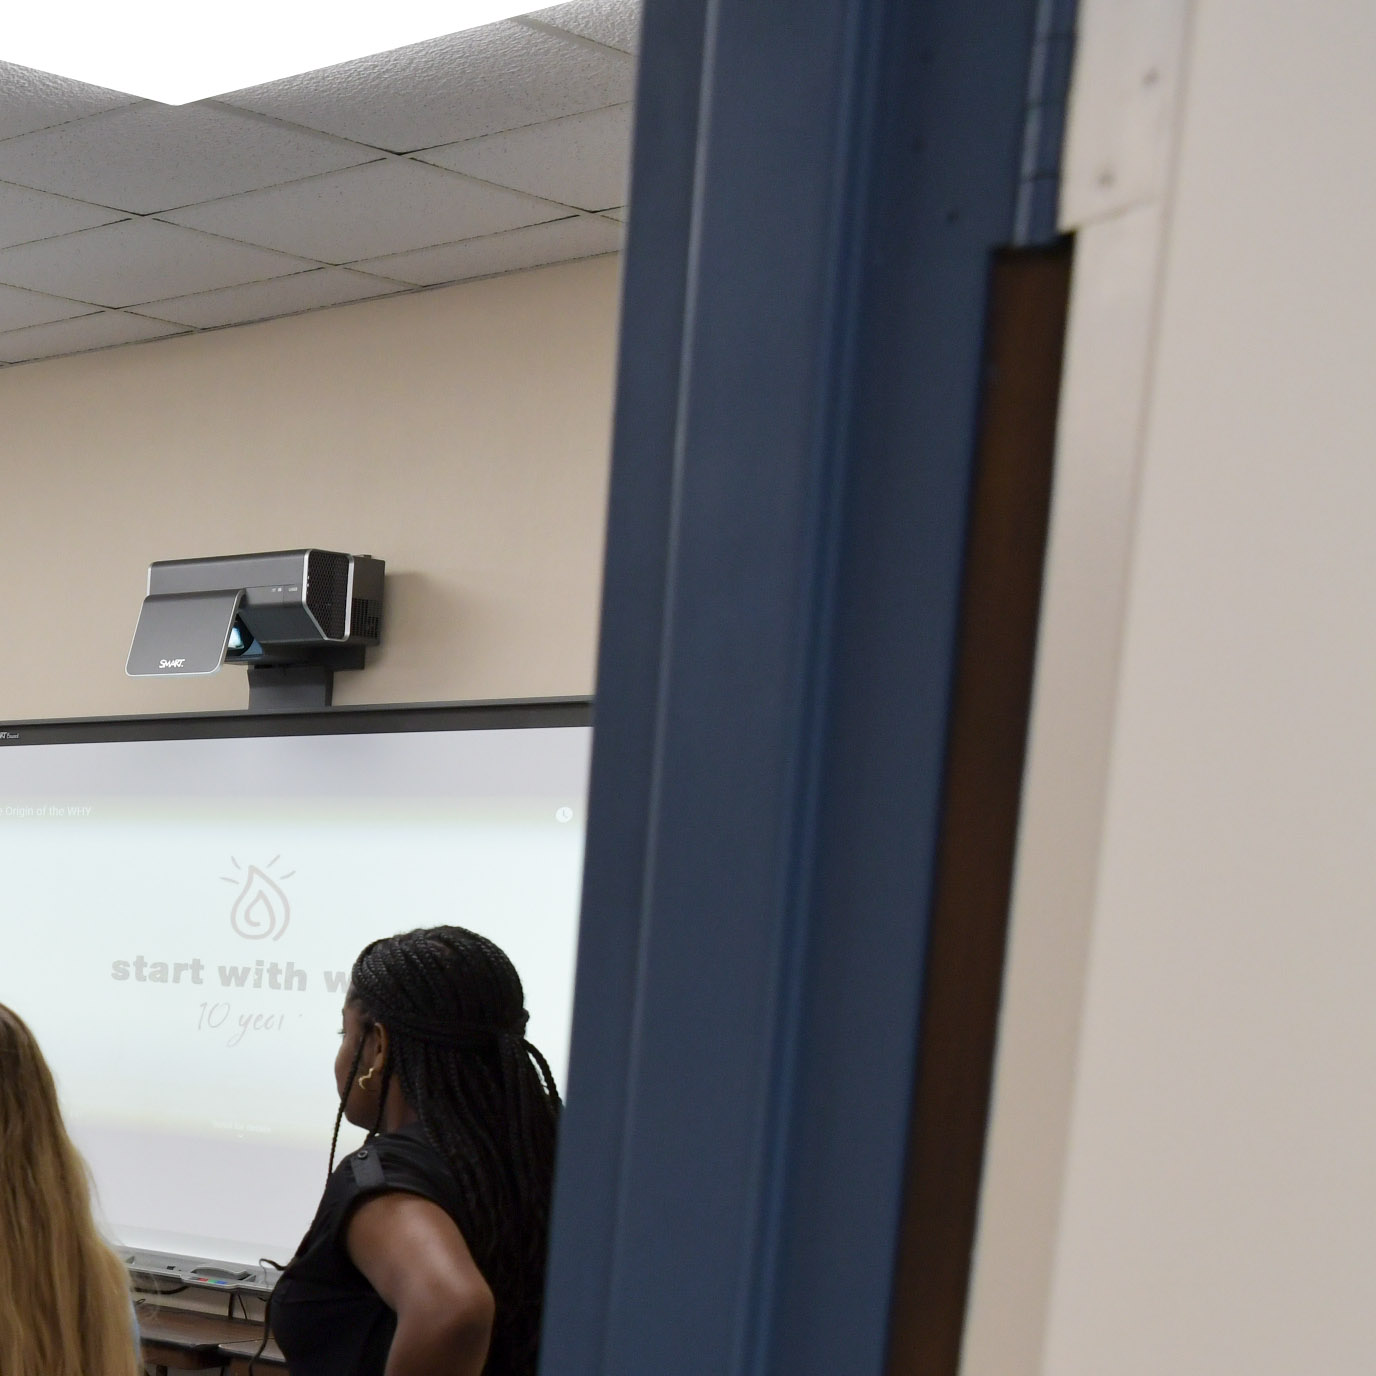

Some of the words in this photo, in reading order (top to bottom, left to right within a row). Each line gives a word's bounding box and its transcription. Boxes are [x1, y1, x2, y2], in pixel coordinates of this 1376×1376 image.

[5, 805, 34, 817] Origin
[36, 805, 46, 816] of
[49, 805, 64, 816] the
[67, 806, 92, 816] WHY
[111, 955, 205, 985] start
[217, 959, 308, 992] with
[197, 1001, 231, 1031] 10
